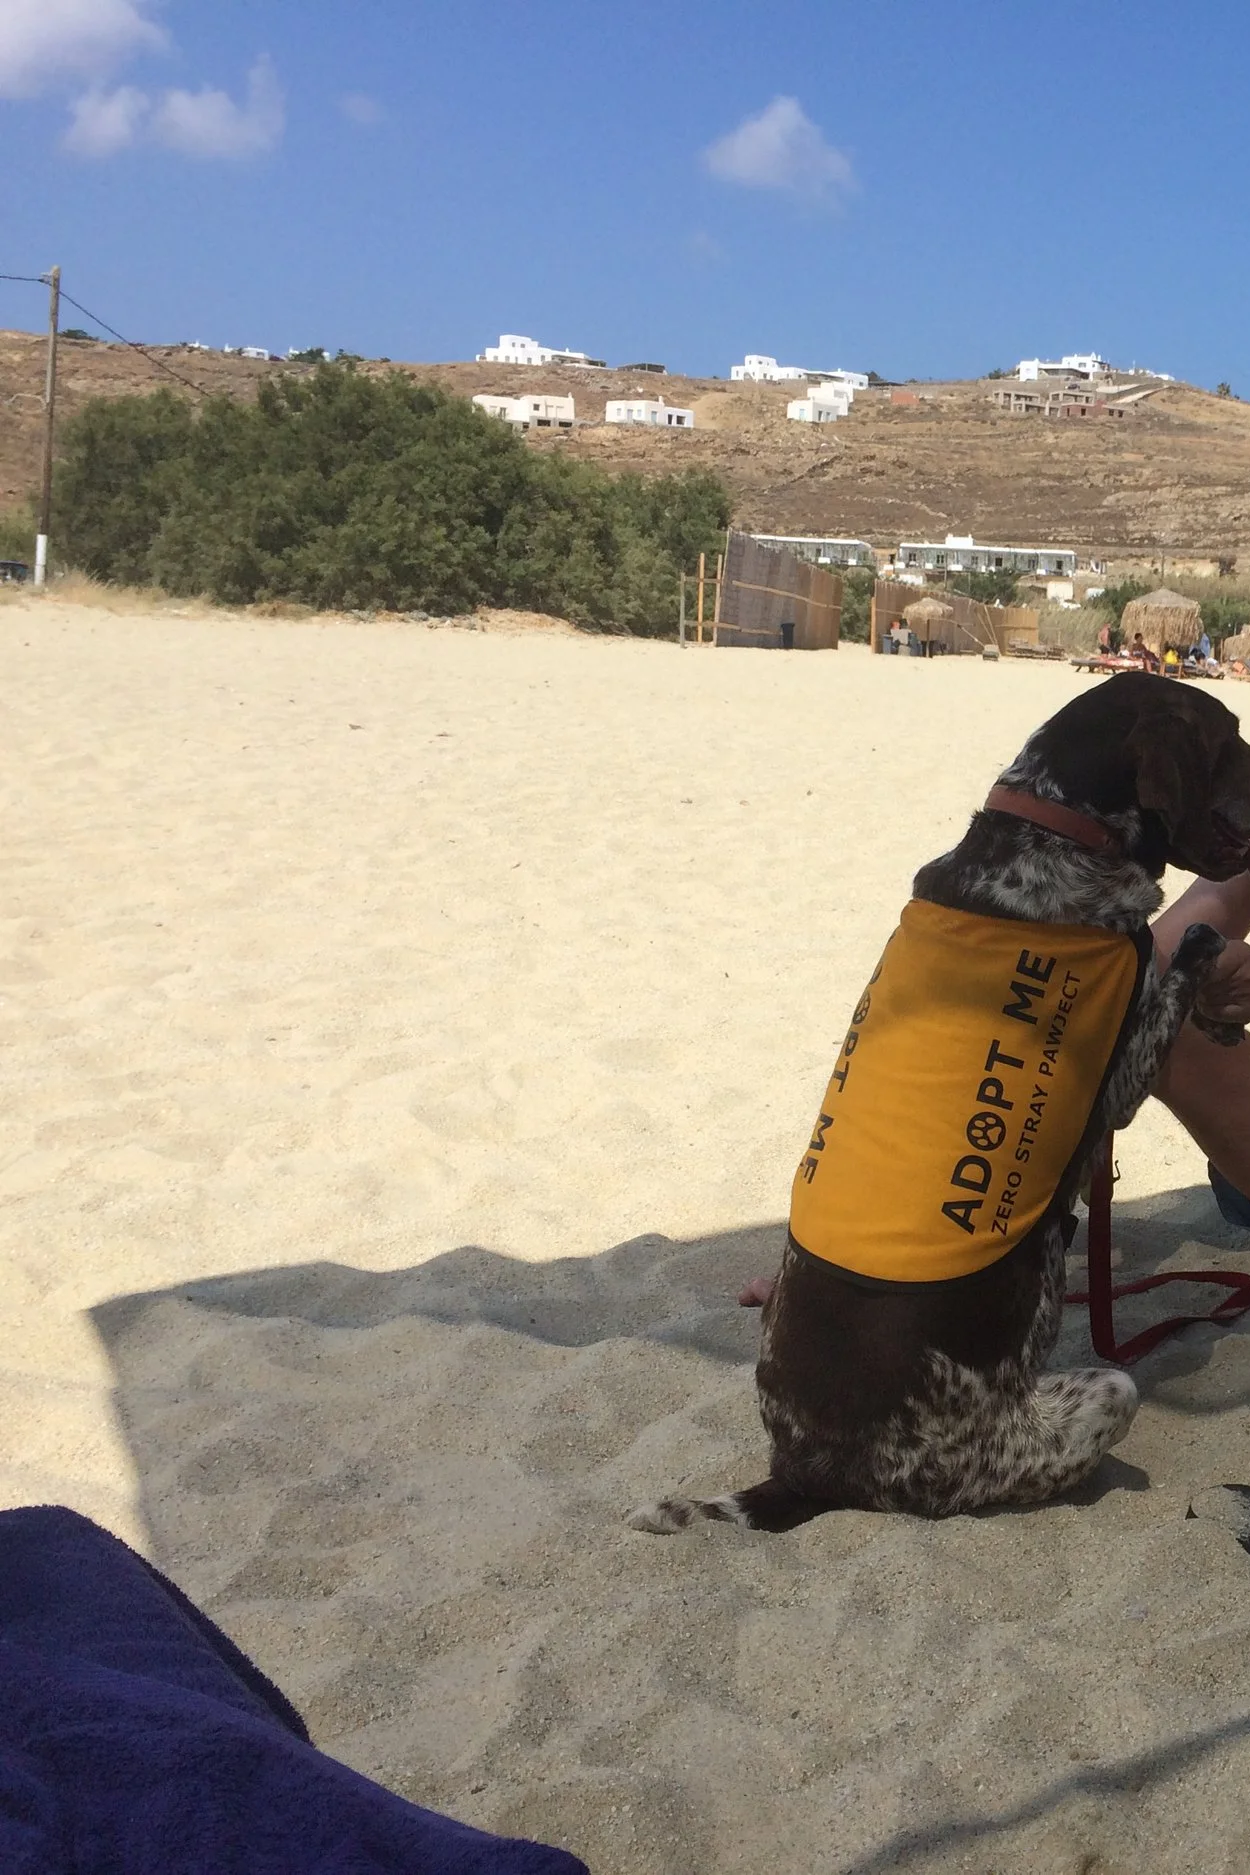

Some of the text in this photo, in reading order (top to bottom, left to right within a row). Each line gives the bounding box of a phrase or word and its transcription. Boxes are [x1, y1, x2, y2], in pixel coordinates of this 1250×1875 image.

[941, 948, 1057, 1235] ADOPT ME
[991, 970, 1082, 1236] ZERO STRAY PAWJECT
